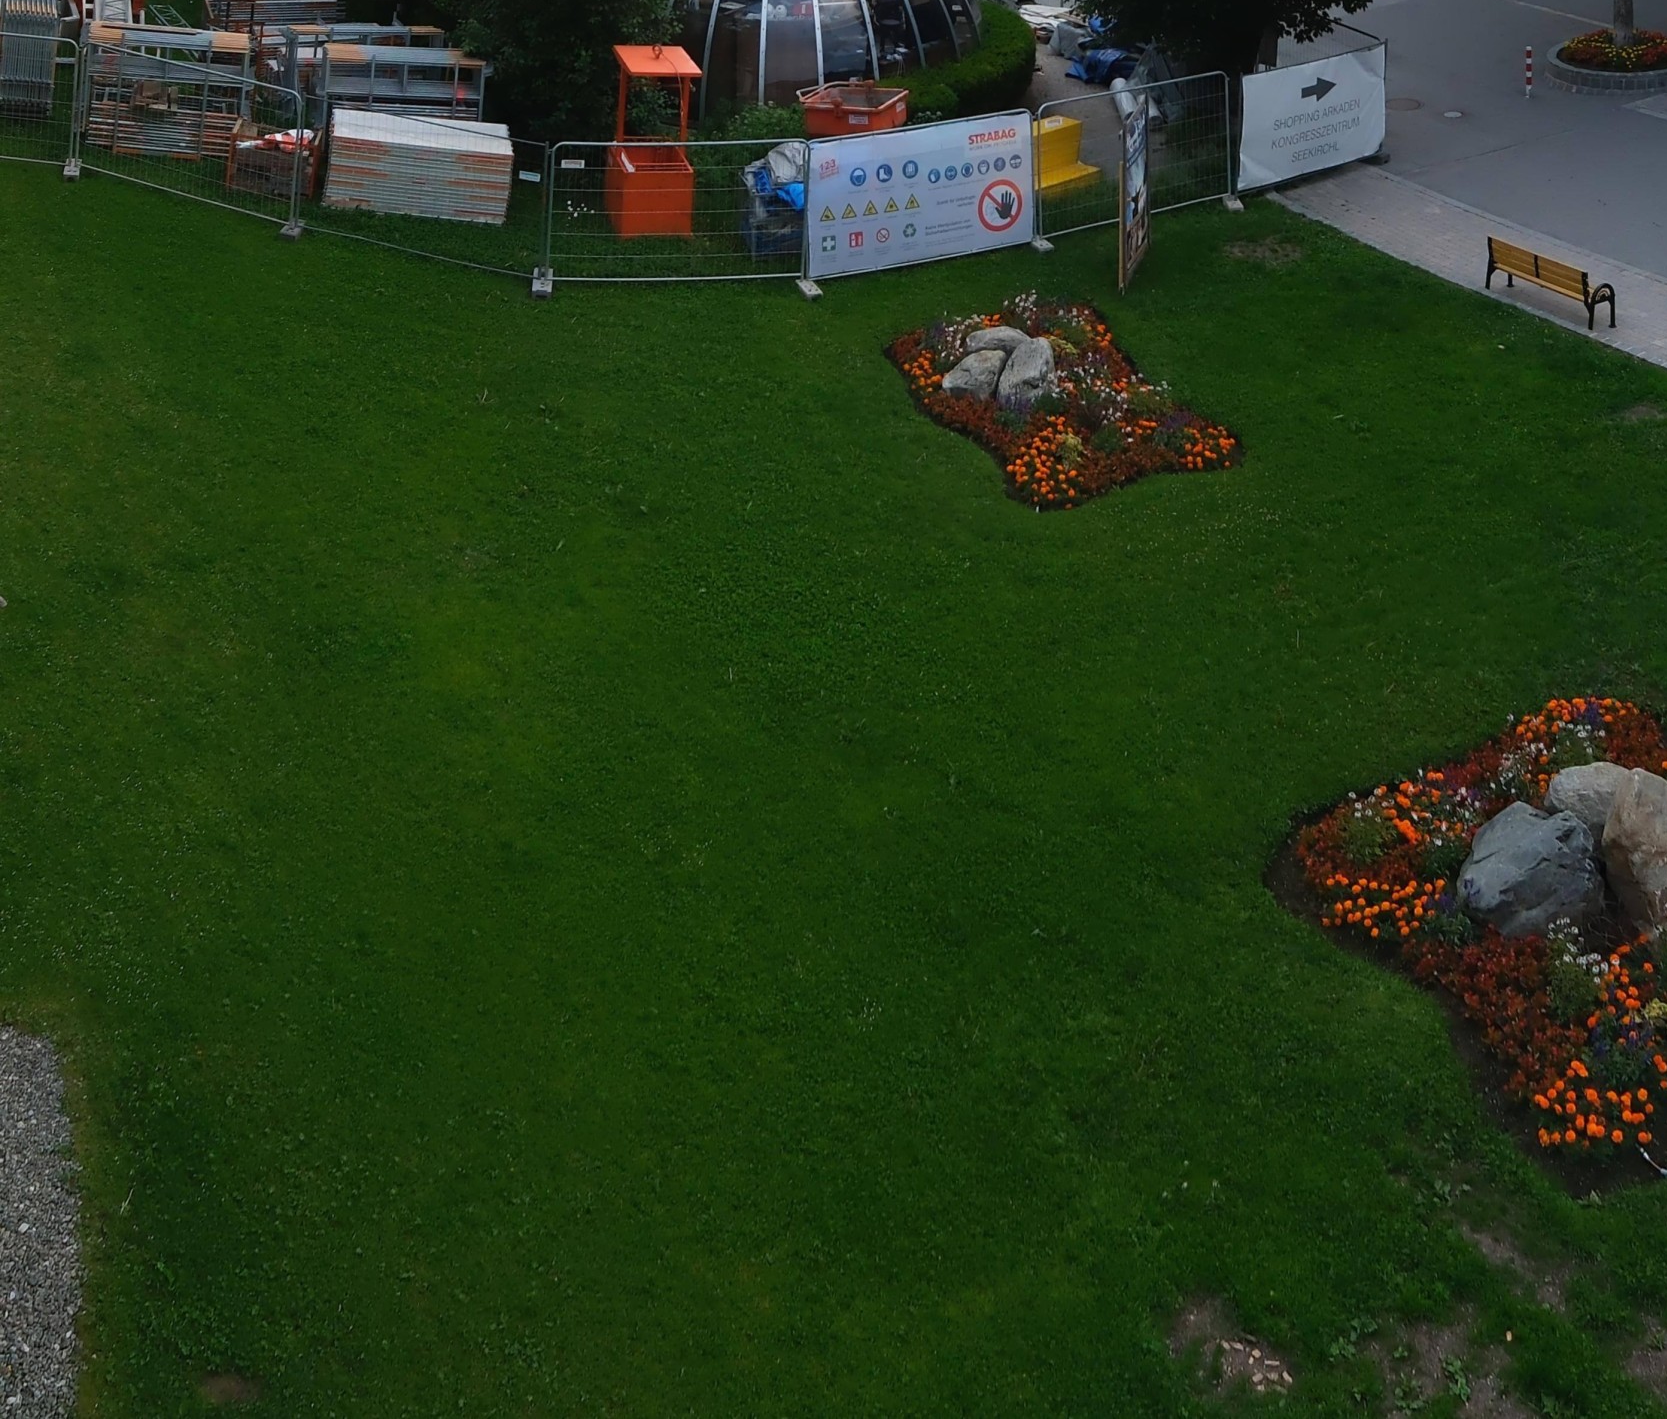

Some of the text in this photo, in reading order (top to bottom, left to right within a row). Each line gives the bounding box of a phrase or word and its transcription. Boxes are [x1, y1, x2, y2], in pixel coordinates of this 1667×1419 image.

[1273, 99, 1361, 131] SHOPPING ARKADEN
[968, 128, 1016, 145] STRABAG
[1271, 116, 1361, 150] KONGRESSZENTRUM
[1291, 141, 1340, 163] SEEKIRCHL
